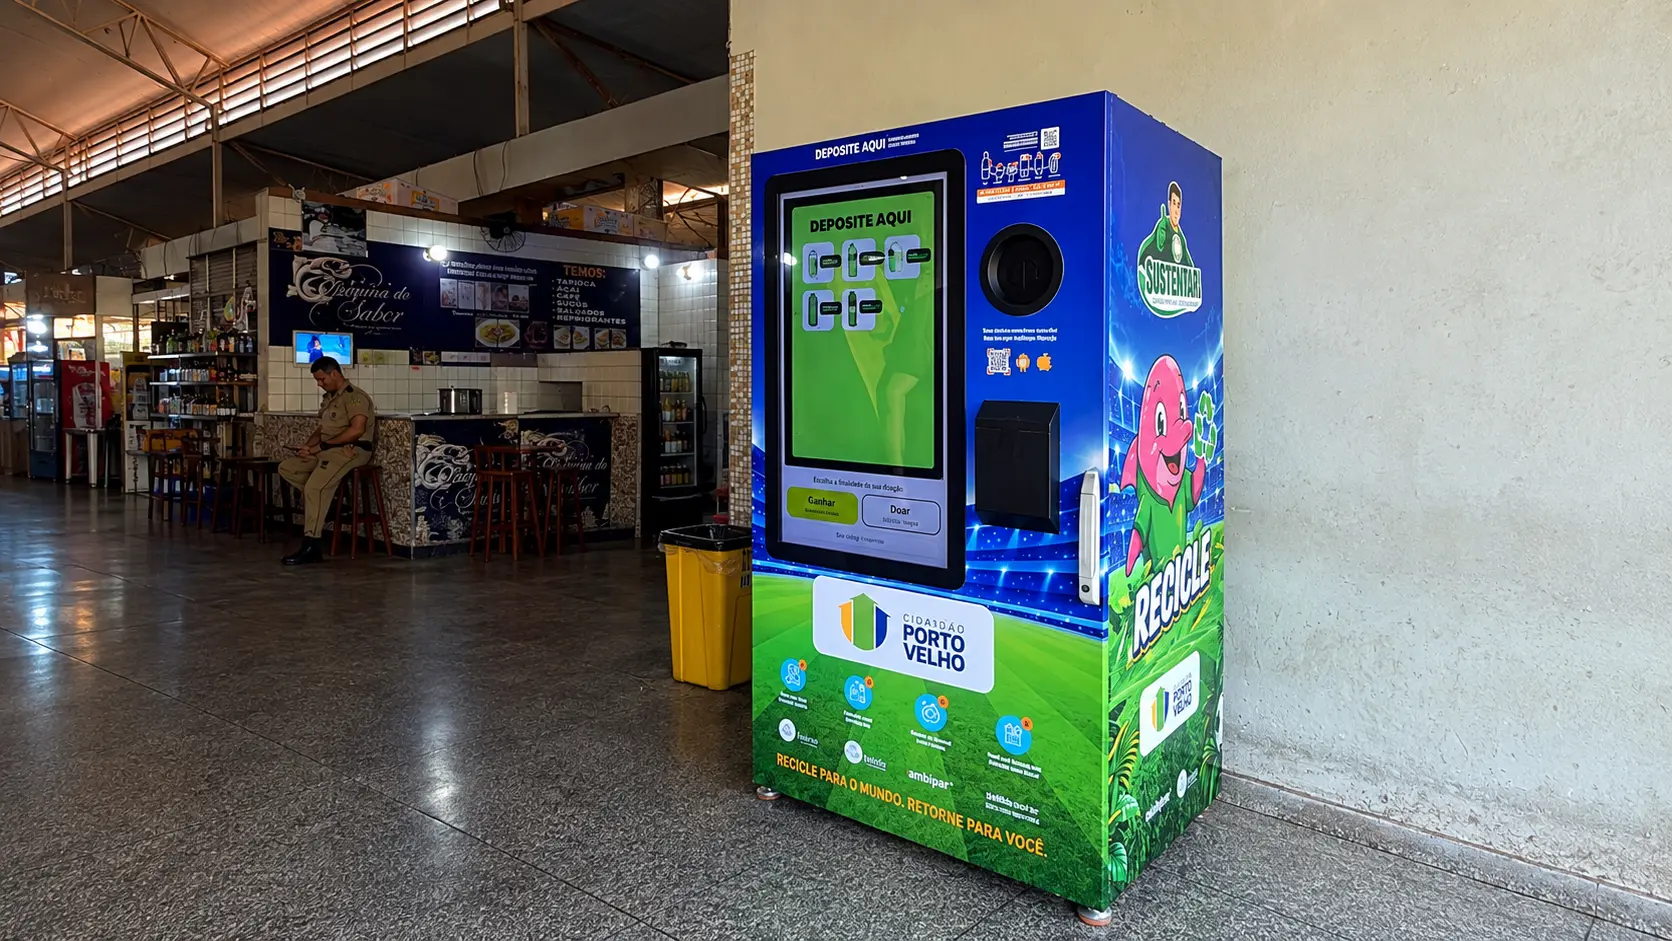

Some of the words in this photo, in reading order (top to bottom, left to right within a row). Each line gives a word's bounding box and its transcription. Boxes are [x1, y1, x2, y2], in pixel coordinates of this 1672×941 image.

[815, 142, 860, 160] DEPOSITE
[861, 138, 886, 153] AQUI
[810, 213, 874, 232] DEPOSITE
[876, 209, 912, 227] AQUI
[563, 265, 606, 278] TEMOS:
[808, 495, 836, 507] Ganhar
[890, 504, 911, 515] Doar
[1131, 529, 1212, 660] RECICLE
[903, 623, 965, 653] PORTO
[903, 642, 965, 672] VELHO
[776, 752, 818, 778] RECICLE
[819, 768, 847, 788] PARA
[849, 778, 858, 791] O
[860, 781, 904, 808] MUNDO.
[907, 796, 964, 829] RETORNE
[967, 817, 1003, 842] PARA
[1005, 829, 1048, 858] VOCÊ.
